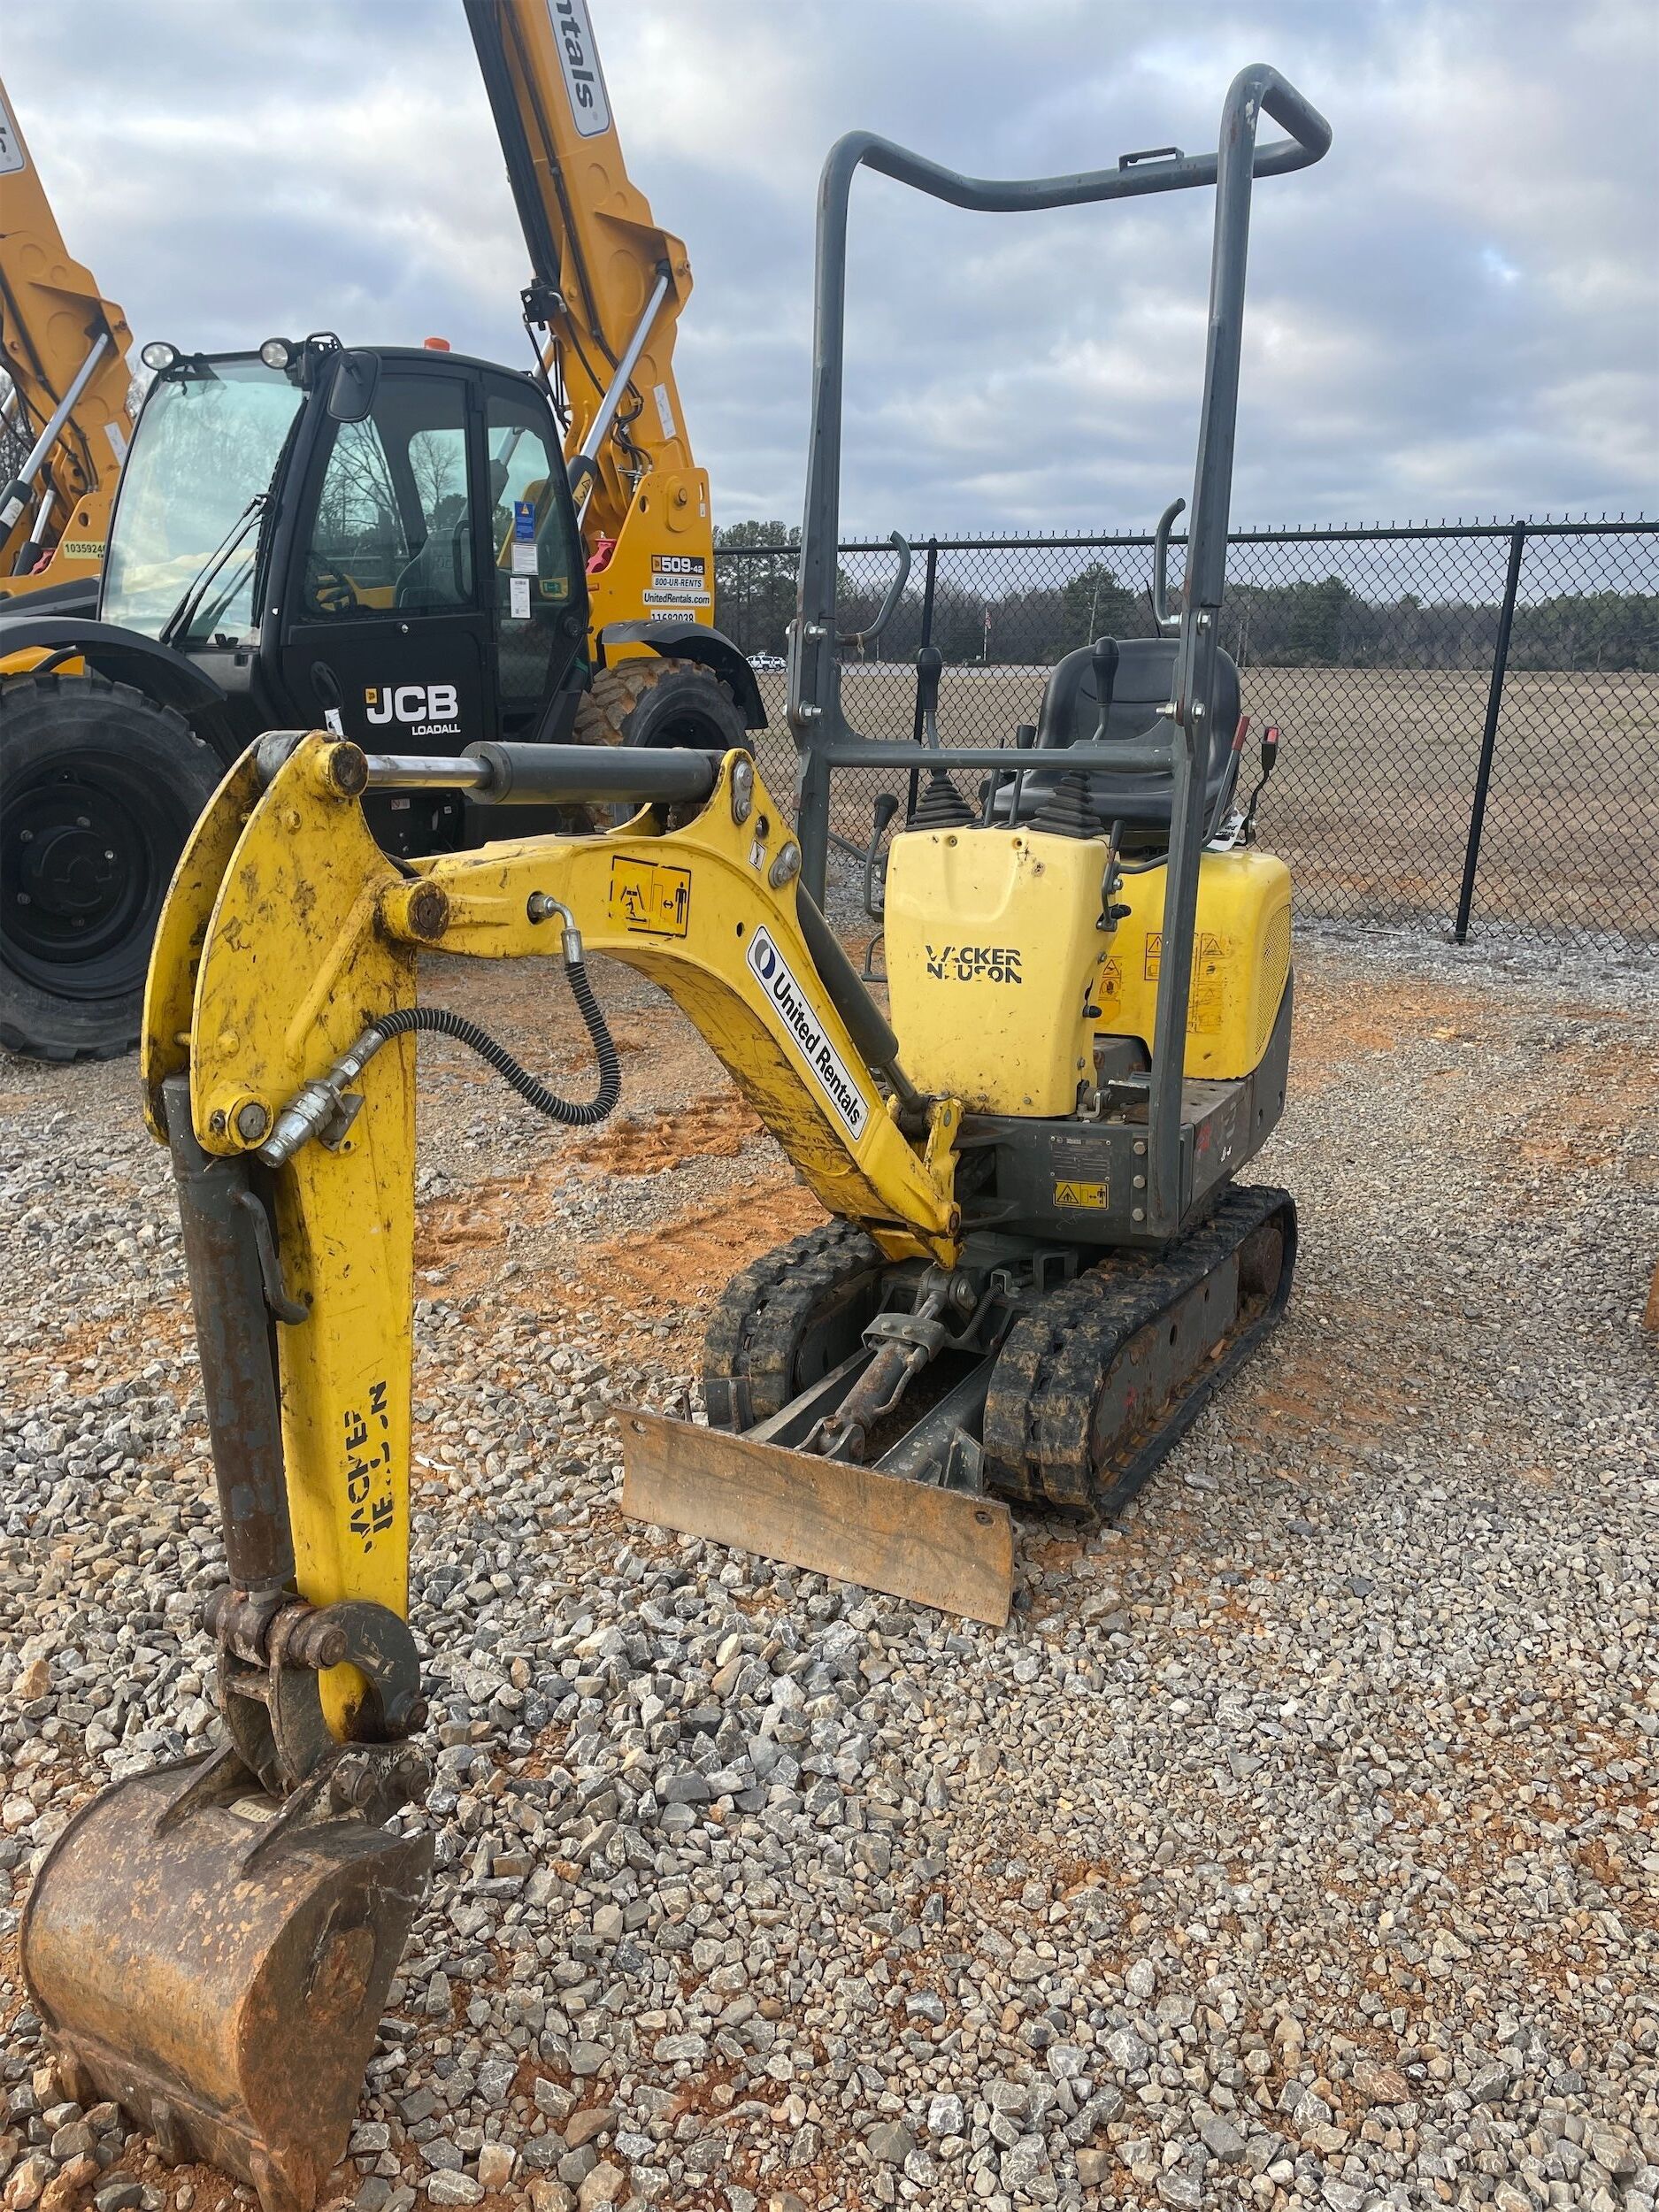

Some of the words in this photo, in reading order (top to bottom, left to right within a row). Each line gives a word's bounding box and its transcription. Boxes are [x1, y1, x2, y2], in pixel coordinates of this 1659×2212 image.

[655, 578, 702, 588] 800-UR-RENTS
[644, 593, 710, 604] UnitedRentals.com
[366, 685, 458, 724] JCB
[411, 724, 461, 735] LOADALL
[927, 963, 1022, 984] NUON
[773, 972, 820, 1055] United
[816, 1045, 861, 1125] Rentals
